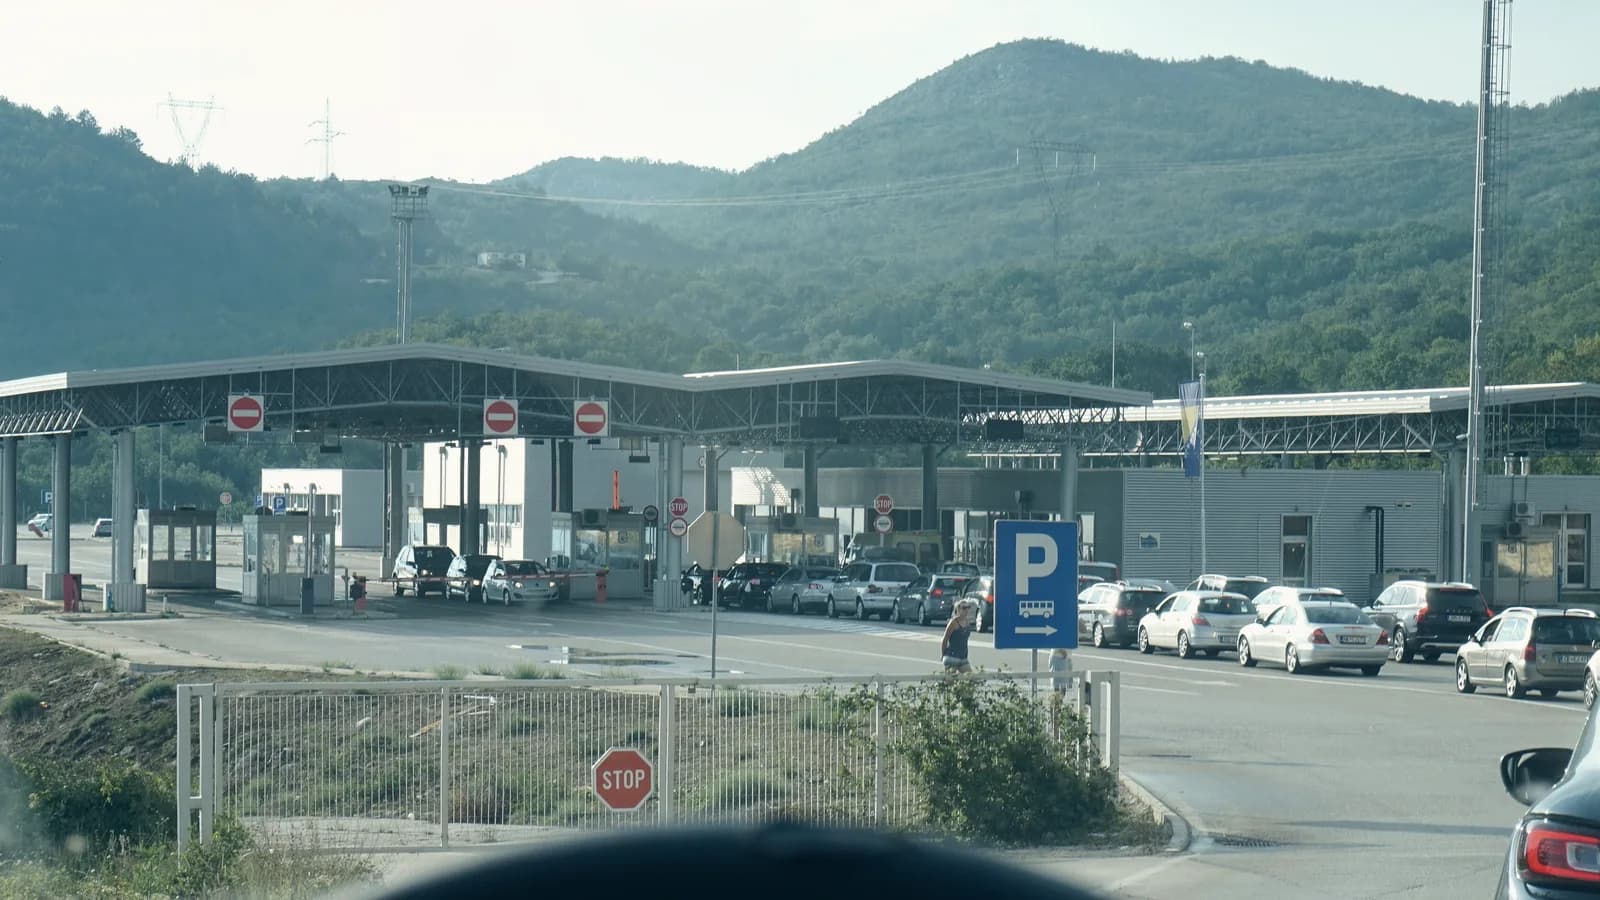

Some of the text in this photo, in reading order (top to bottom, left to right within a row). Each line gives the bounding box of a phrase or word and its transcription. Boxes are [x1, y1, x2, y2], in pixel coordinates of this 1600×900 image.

[276, 498, 284, 508] P
[671, 502, 688, 511] STOP
[876, 499, 892, 508] STOP
[1016, 533, 1058, 595] P
[602, 769, 645, 790] STOP
